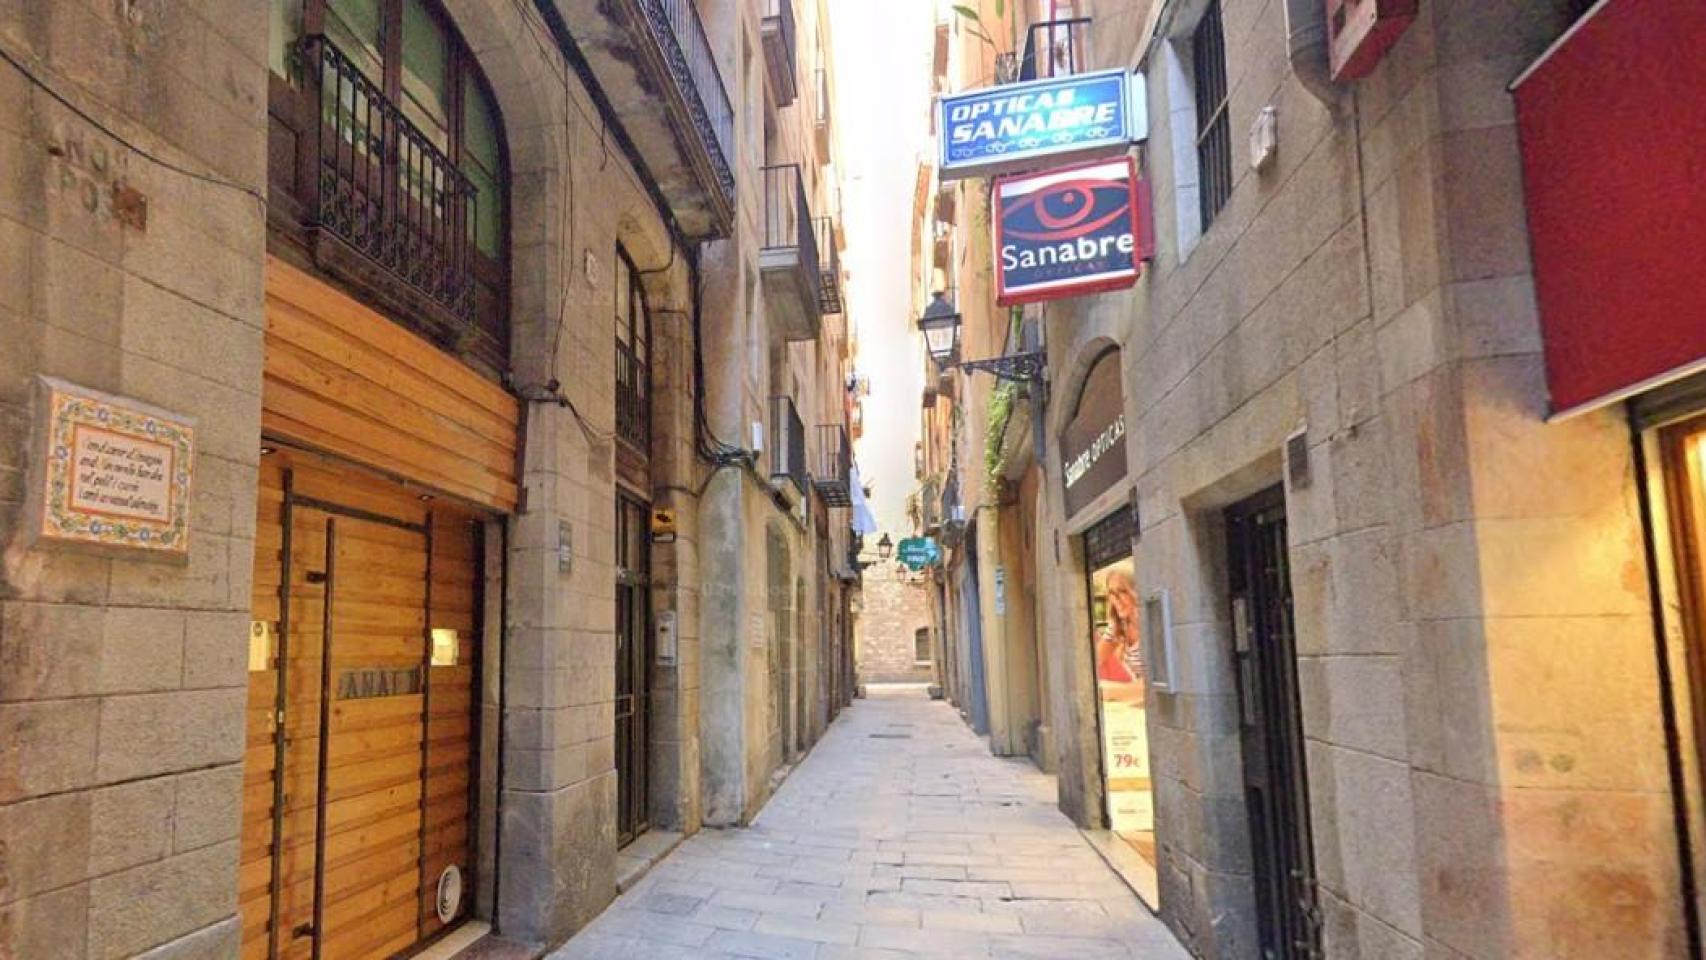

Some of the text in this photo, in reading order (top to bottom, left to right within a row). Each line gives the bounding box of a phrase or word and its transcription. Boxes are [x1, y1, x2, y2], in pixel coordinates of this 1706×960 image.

[951, 102, 1117, 143] SANABRE
[952, 88, 1076, 122] OPTICAS
[1002, 233, 1134, 271] Sanabre
[1091, 414, 1125, 462] OPTICAS
